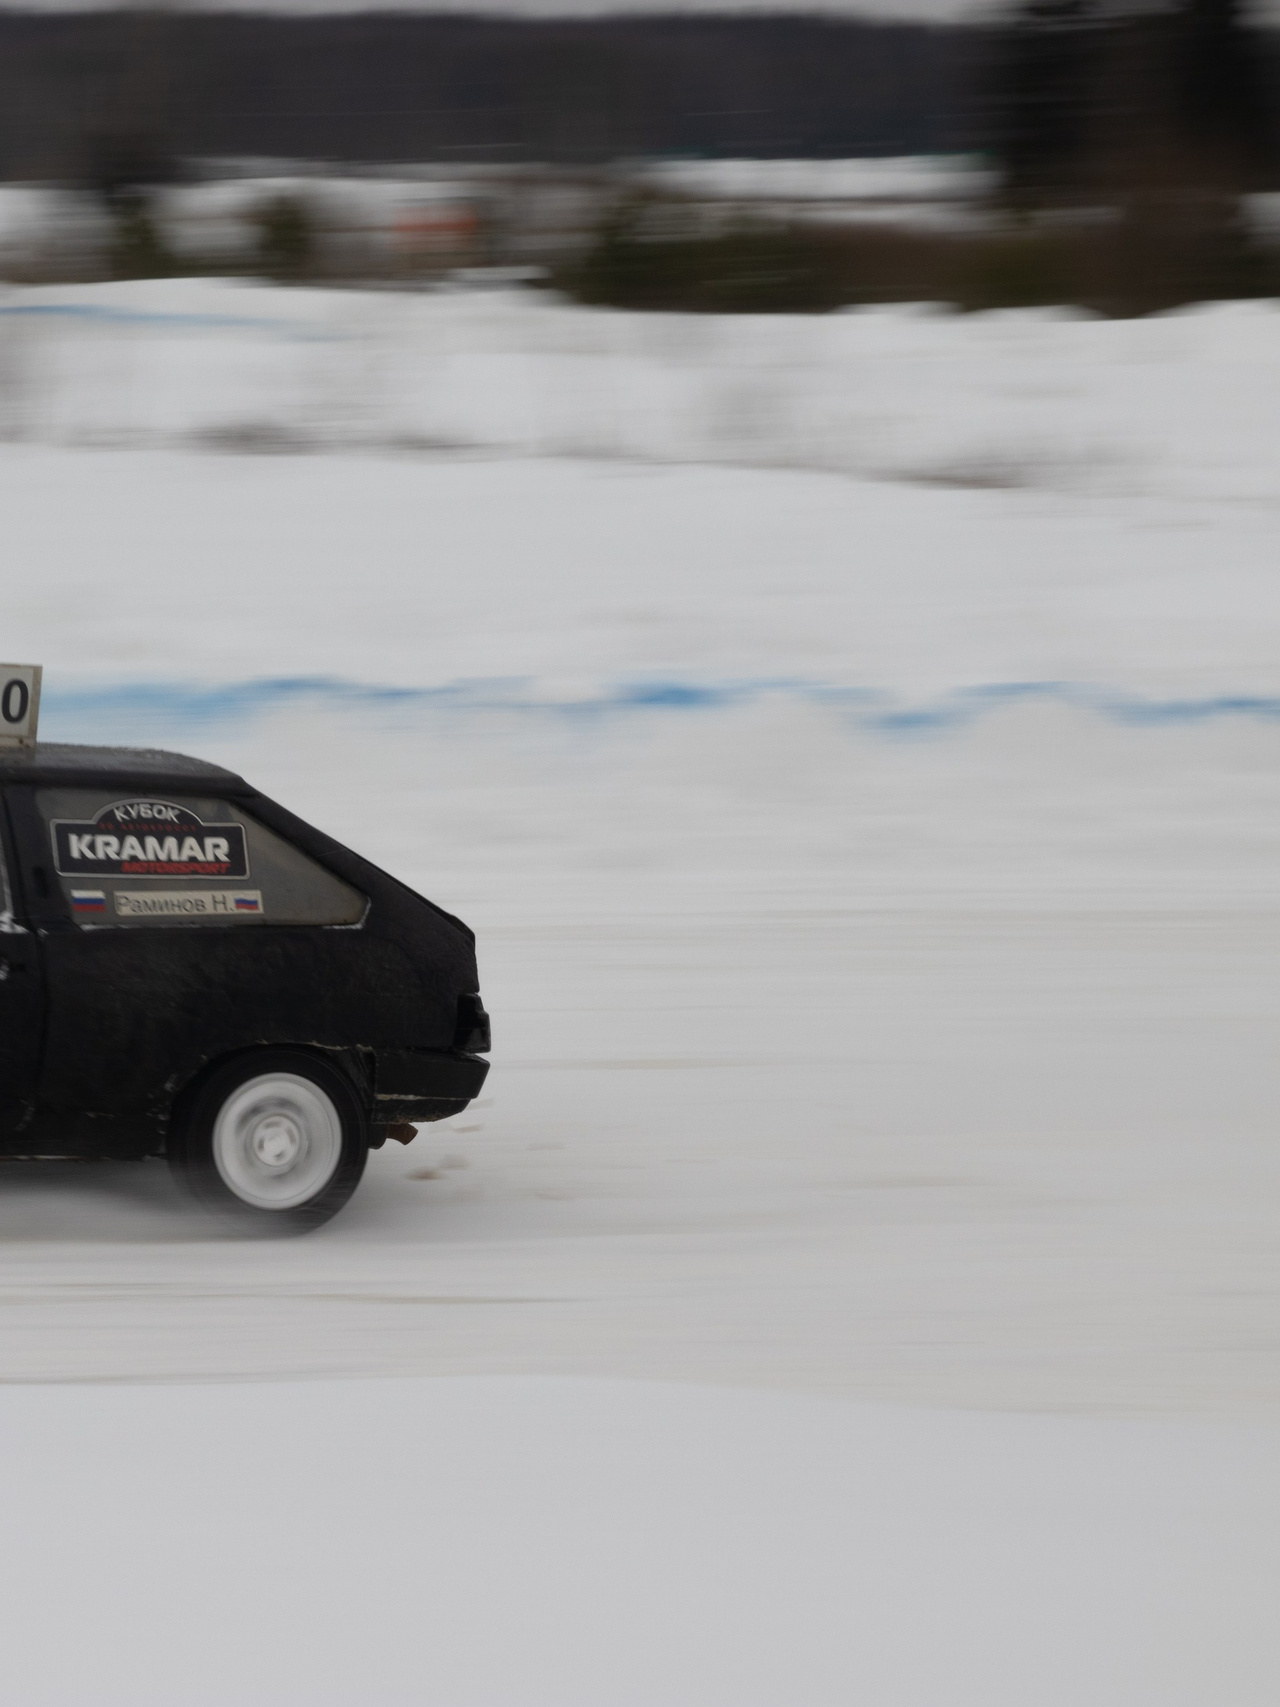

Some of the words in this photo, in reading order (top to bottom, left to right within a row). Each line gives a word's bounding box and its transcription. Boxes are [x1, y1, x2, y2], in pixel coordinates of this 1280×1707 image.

[113, 803, 180, 824] КУБОК
[68, 833, 231, 862] KRAMAR
[118, 894, 207, 913] Раминов
[212, 894, 234, 912] Н.
